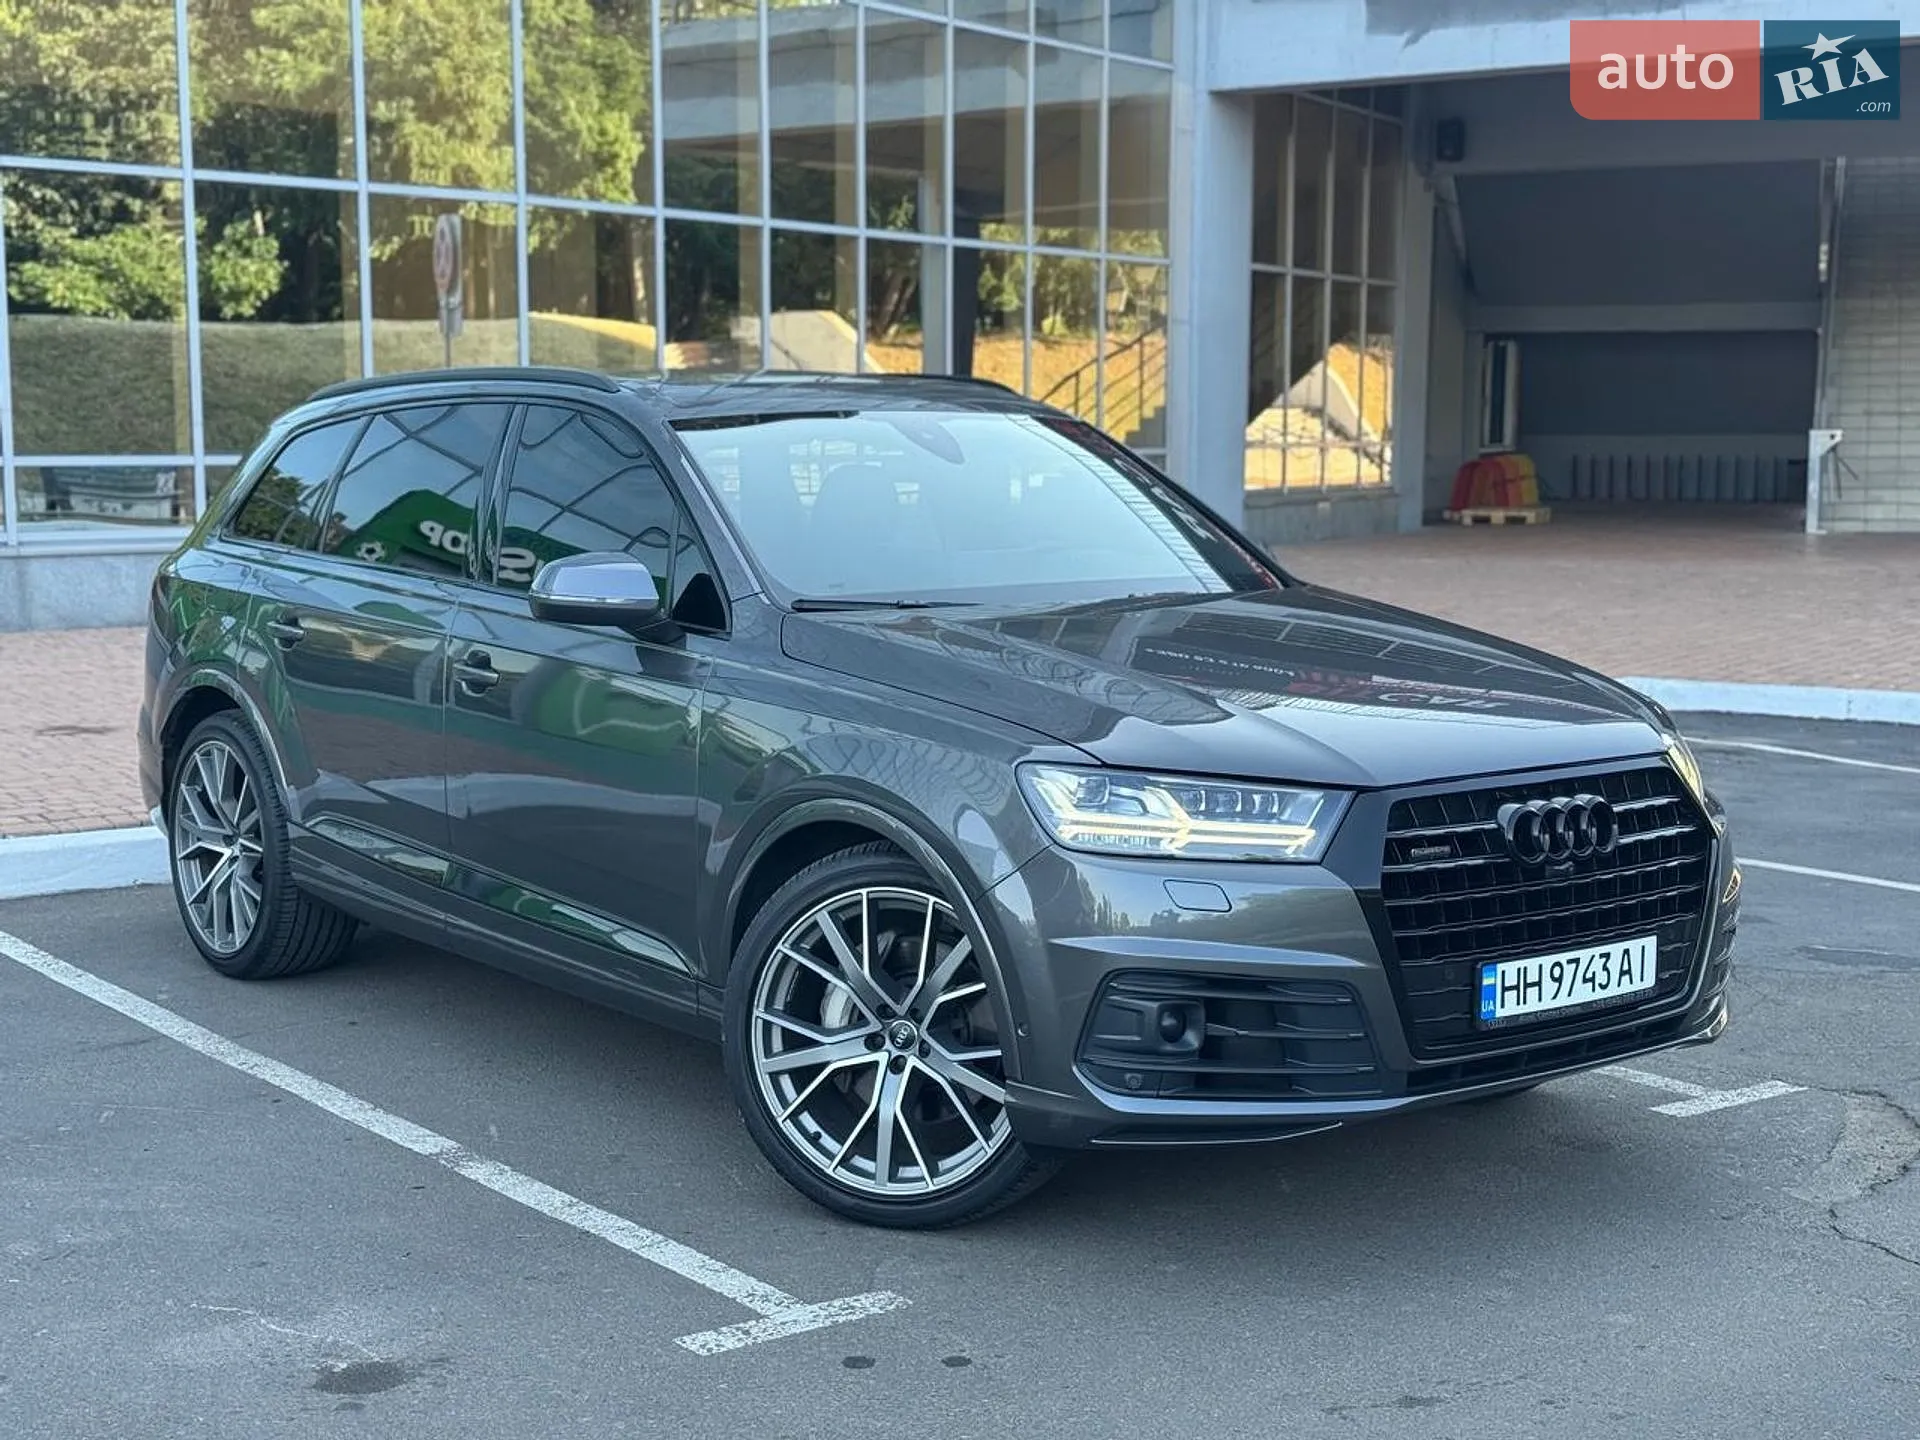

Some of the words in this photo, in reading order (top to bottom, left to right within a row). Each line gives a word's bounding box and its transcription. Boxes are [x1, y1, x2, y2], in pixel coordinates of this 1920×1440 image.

[1500, 963, 1543, 1009] HH
[1549, 952, 1611, 1000] 9743
[1481, 1000, 1495, 1012] UA
